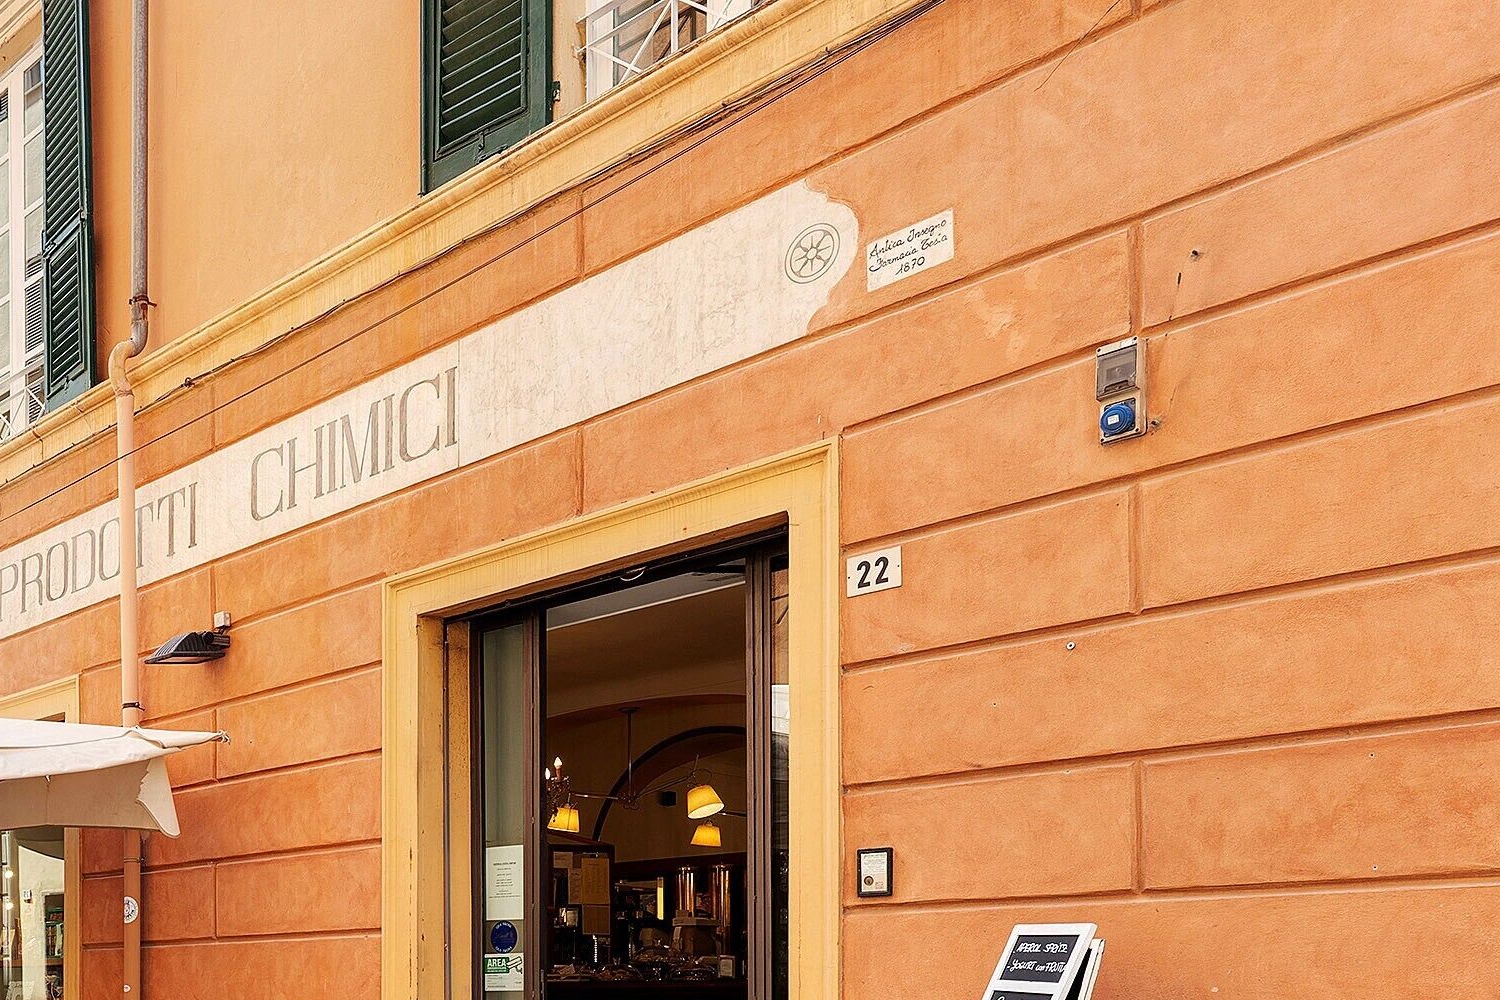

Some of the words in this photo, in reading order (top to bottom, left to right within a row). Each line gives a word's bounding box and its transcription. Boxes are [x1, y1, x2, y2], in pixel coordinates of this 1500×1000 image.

[895, 256, 925, 275] 1870
[250, 366, 458, 521] CHIMICI
[856, 556, 889, 589] 22
[487, 958, 507, 968] AREA
